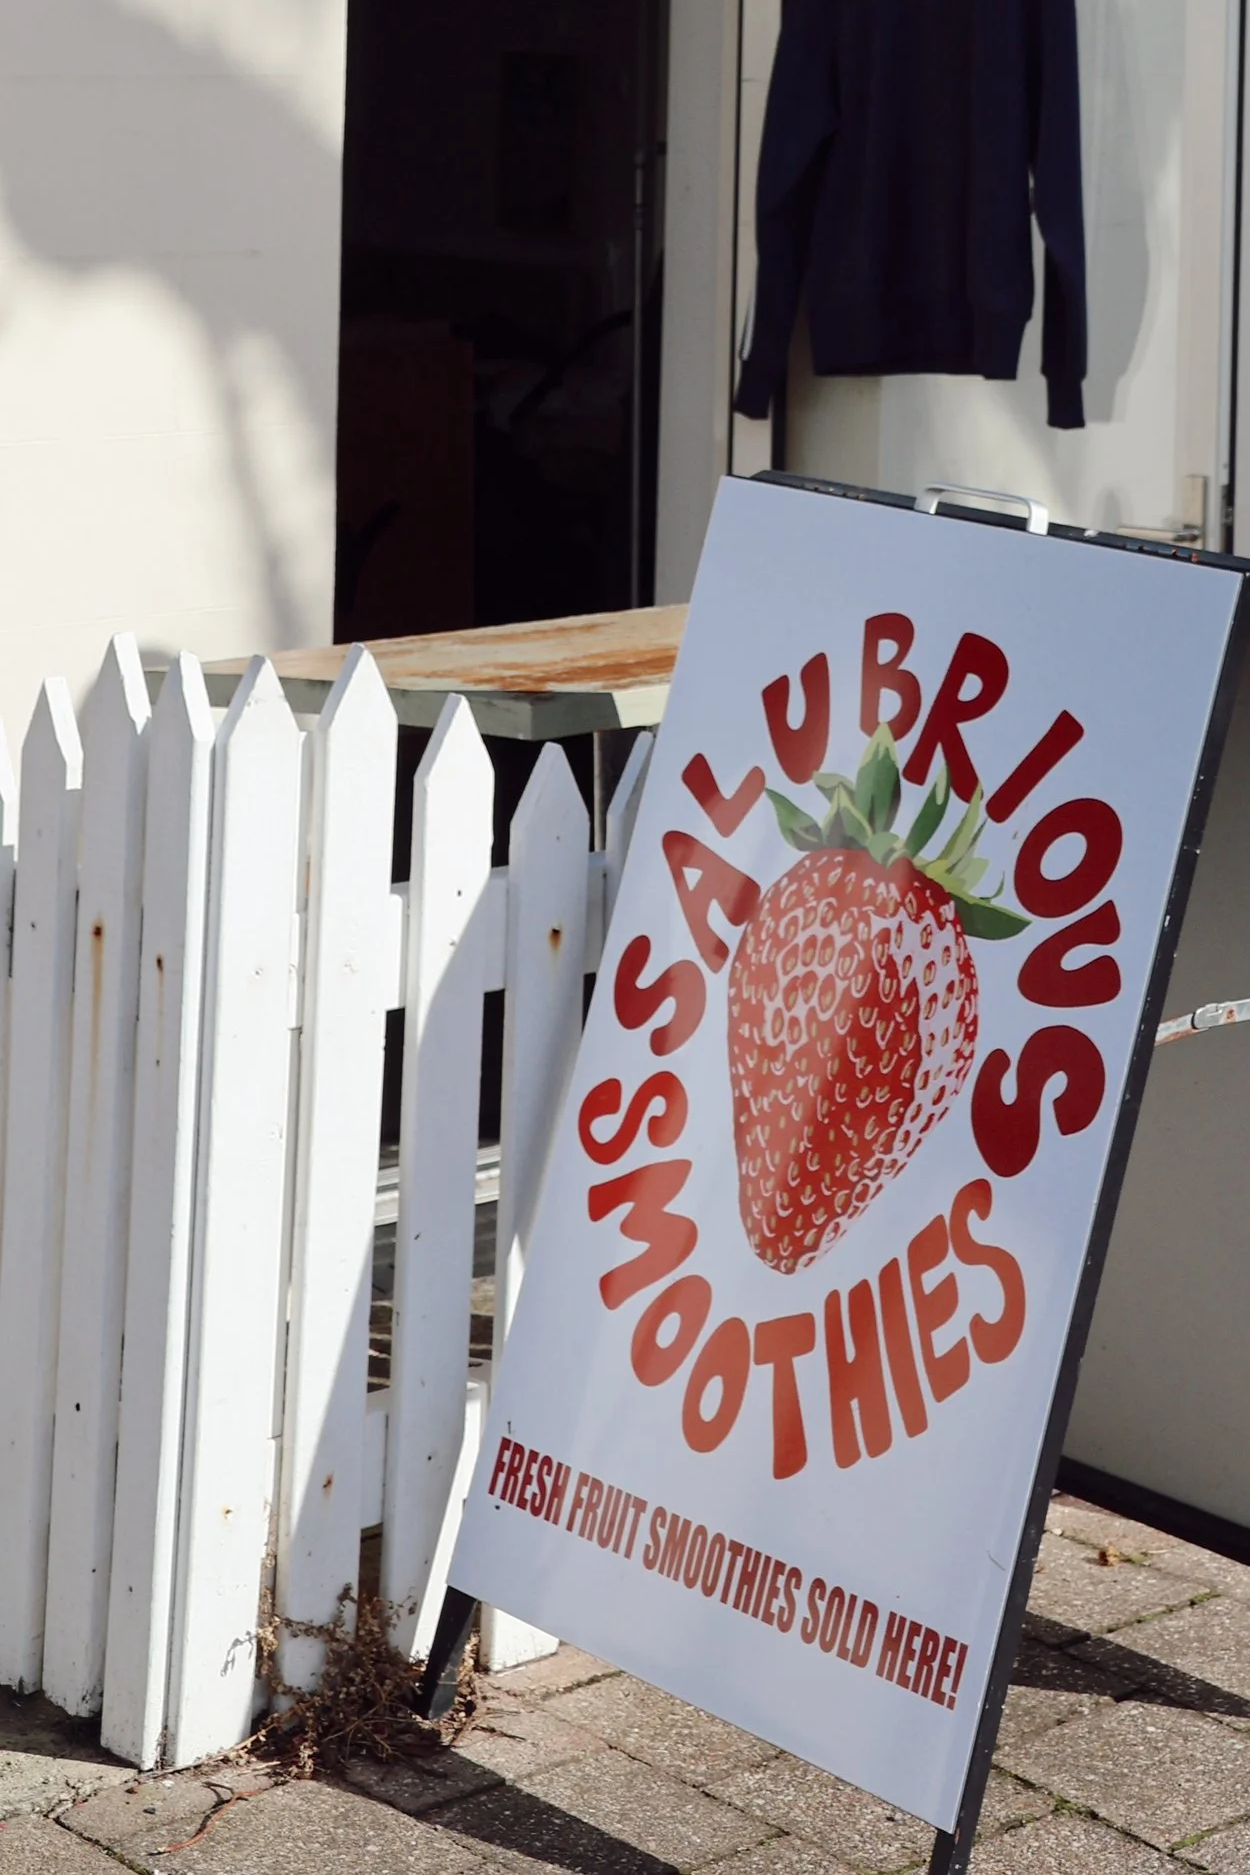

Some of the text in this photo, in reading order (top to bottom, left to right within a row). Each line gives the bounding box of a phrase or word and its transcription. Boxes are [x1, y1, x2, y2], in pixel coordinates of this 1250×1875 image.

[613, 611, 1124, 1178] SALUBRIOUS
[577, 1069, 1027, 1481] SMOOTHIES
[488, 1436, 969, 1711] FRESH FRUIT SMOOTHIES SOLD HERE!
